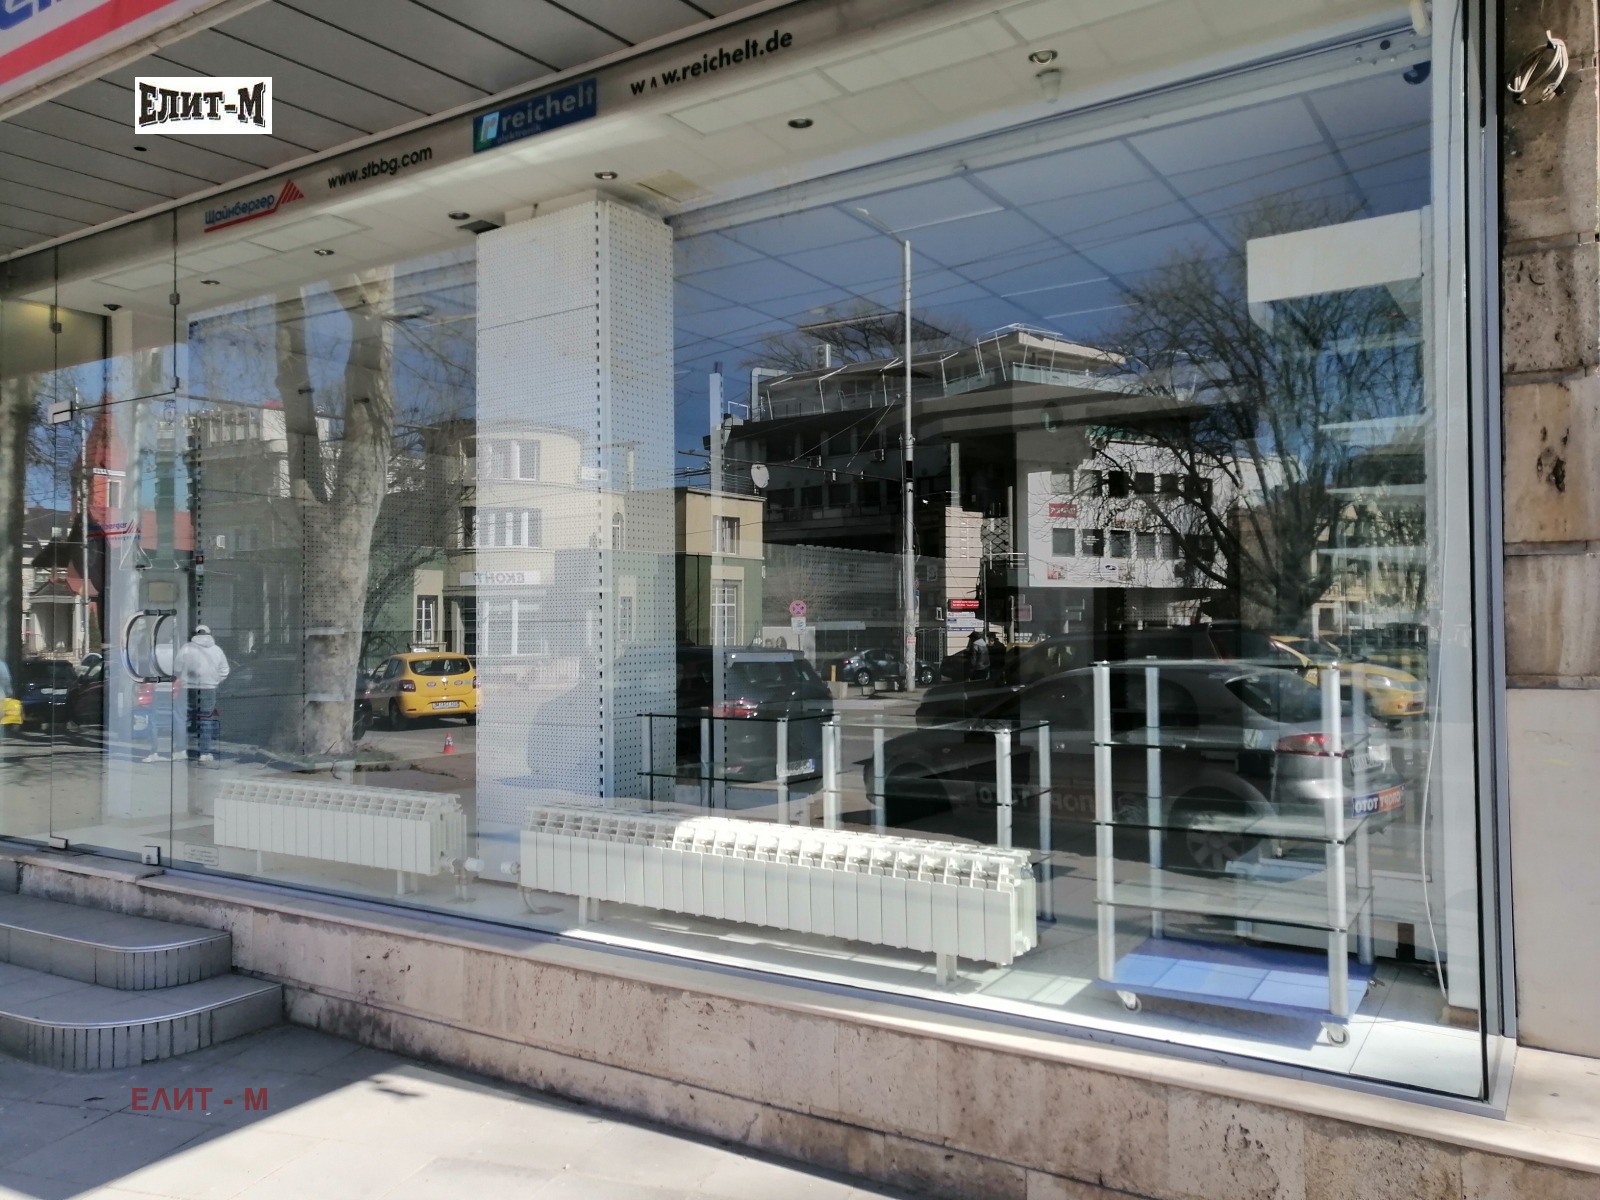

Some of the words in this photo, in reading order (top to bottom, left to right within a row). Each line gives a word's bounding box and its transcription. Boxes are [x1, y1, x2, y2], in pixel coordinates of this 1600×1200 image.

[502, 83, 594, 132] reichelt
[328, 146, 432, 189] www.stbbg.com
[205, 194, 275, 225] Щайнбергер
